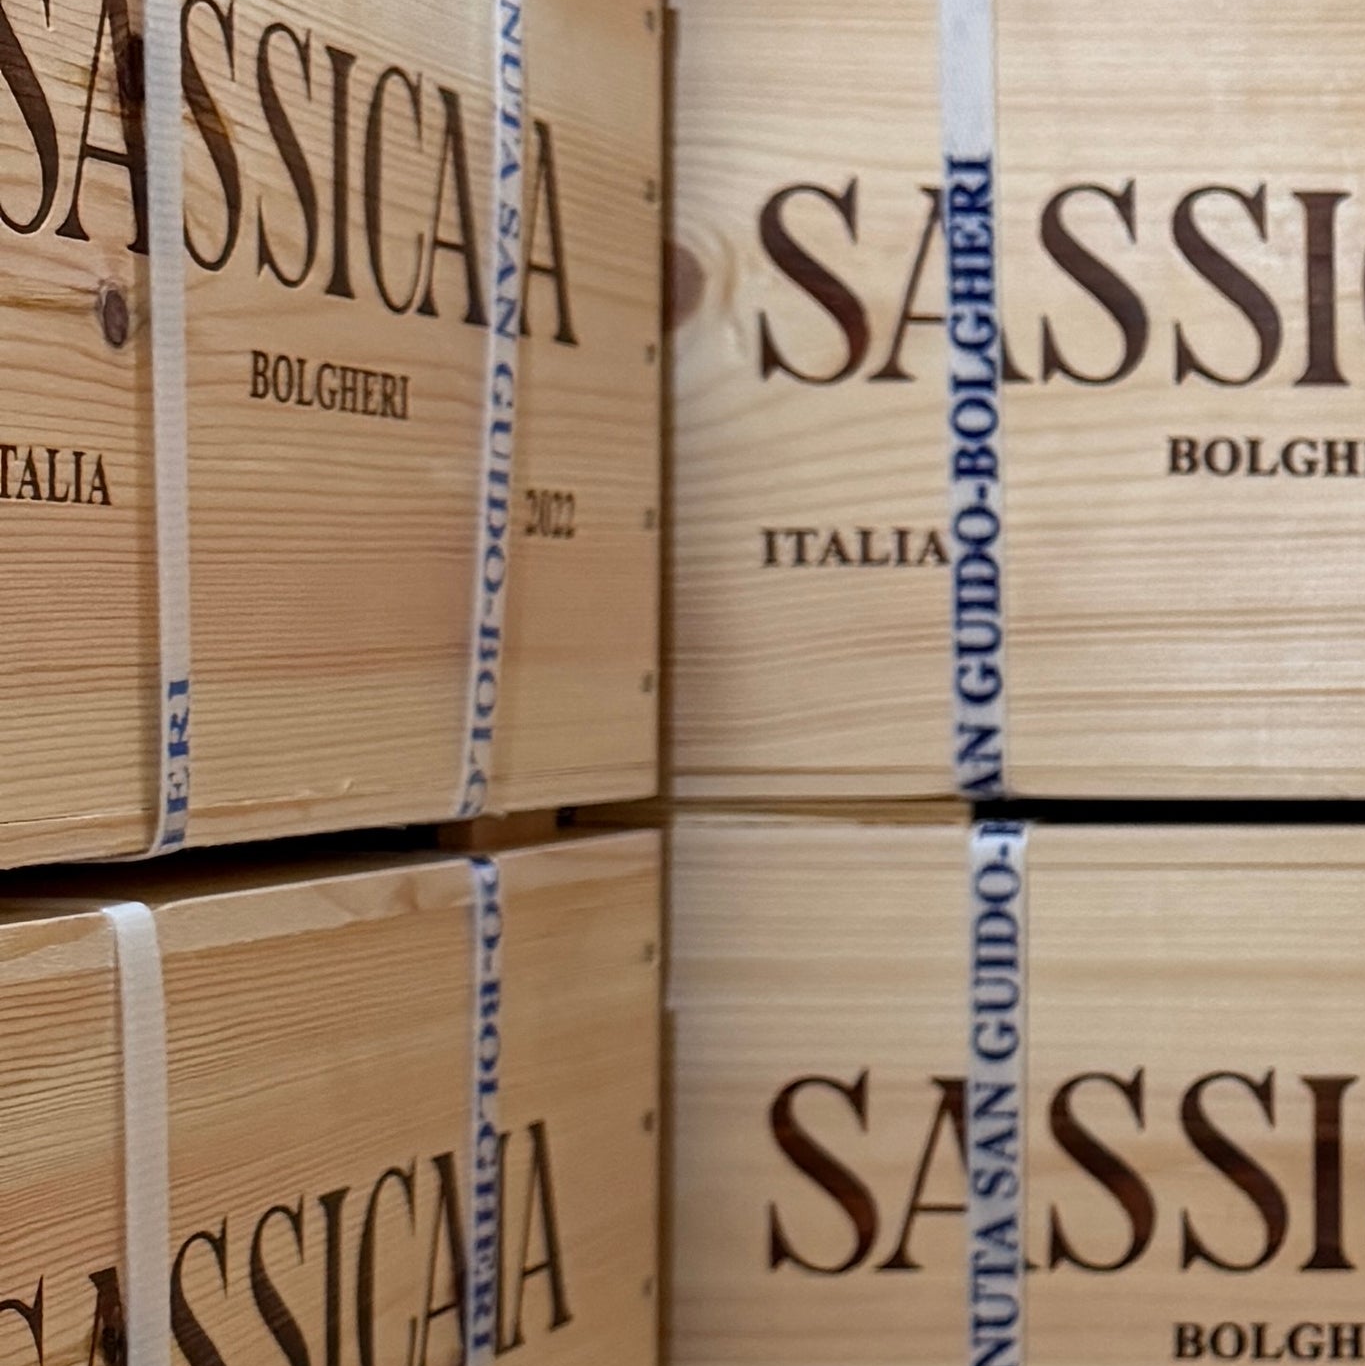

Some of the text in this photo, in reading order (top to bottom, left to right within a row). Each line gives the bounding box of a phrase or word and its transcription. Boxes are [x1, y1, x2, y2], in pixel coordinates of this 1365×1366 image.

[494, 201, 520, 337] SAN
[250, 347, 410, 422] BOLGHERI
[947, 154, 1003, 705] GUIDO-BOLGHERI
[760, 527, 951, 568] ITALIA
[975, 1080, 1020, 1198] SAN
